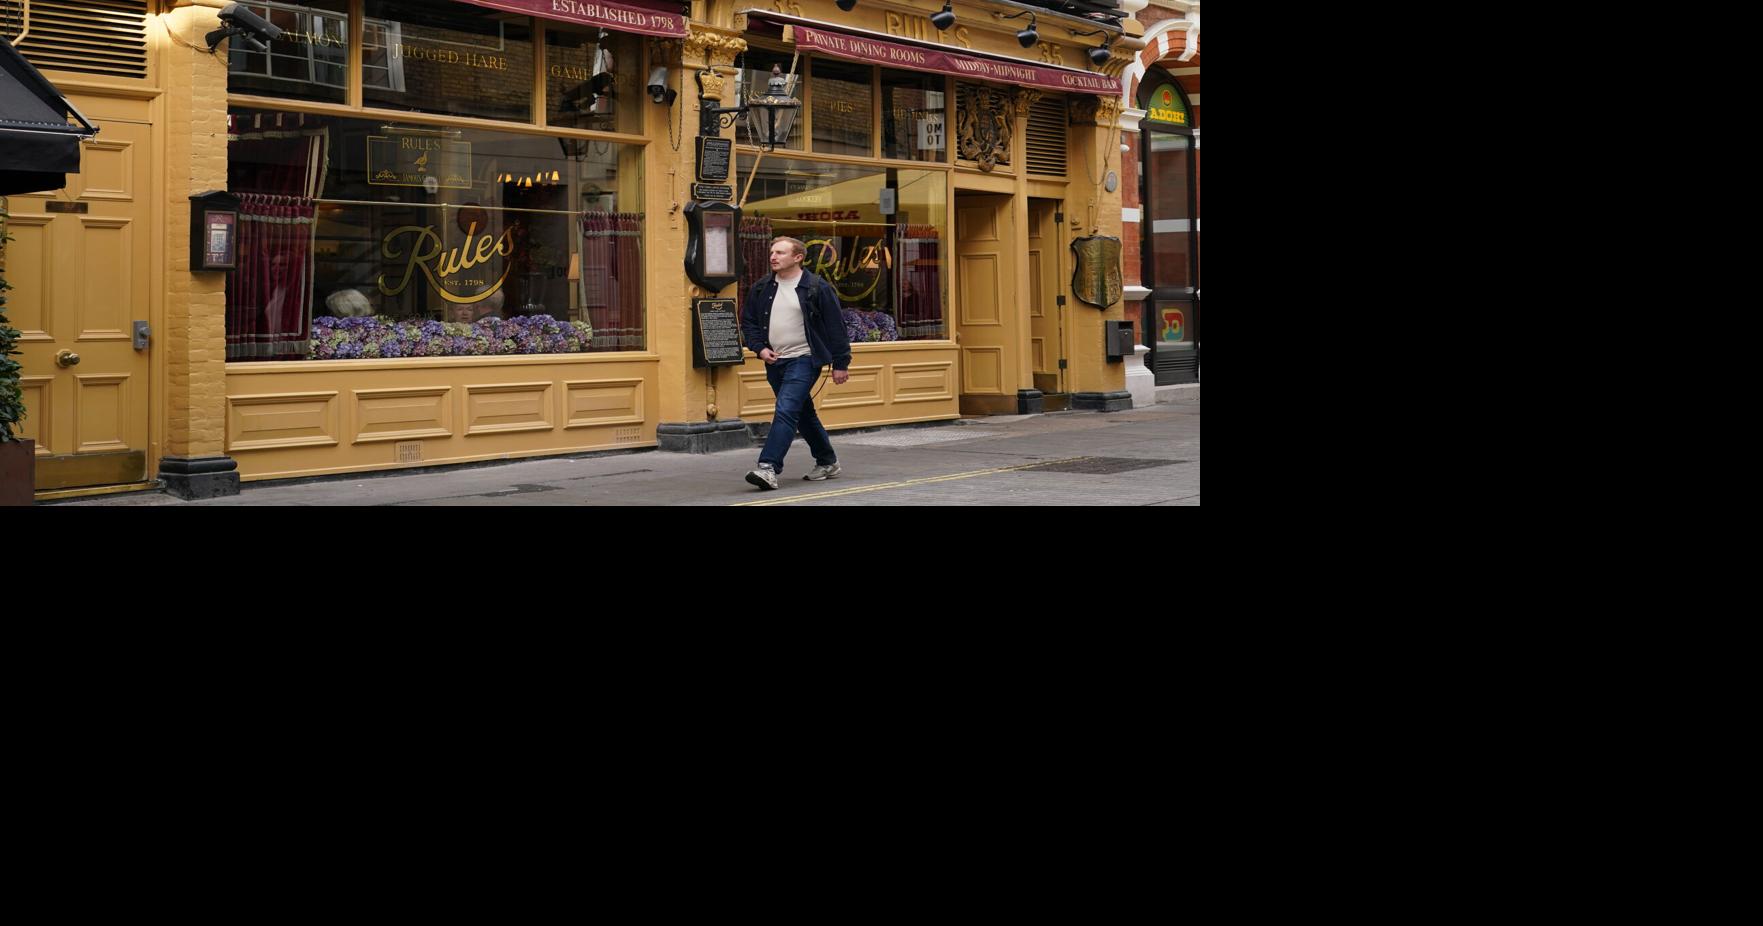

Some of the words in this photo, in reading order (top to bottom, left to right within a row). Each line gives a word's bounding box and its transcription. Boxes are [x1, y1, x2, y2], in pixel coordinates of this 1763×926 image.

[552, 0, 647, 26] ESTABLISHED
[650, 15, 674, 30] 1798
[281, 28, 344, 49] ALMON
[805, 30, 847, 51] PRIVATE
[849, 41, 886, 58] DINING
[889, 48, 926, 64] ROOMS
[392, 43, 459, 64] JUGGED
[464, 52, 509, 71] HARE
[1061, 74, 1101, 88] COCKTAIL
[1101, 78, 1118, 89] BAR
[1150, 107, 1185, 124] ADOH!
[401, 137, 441, 151] RULES
[377, 220, 520, 304] Rules
[463, 279, 485, 287] 1798
